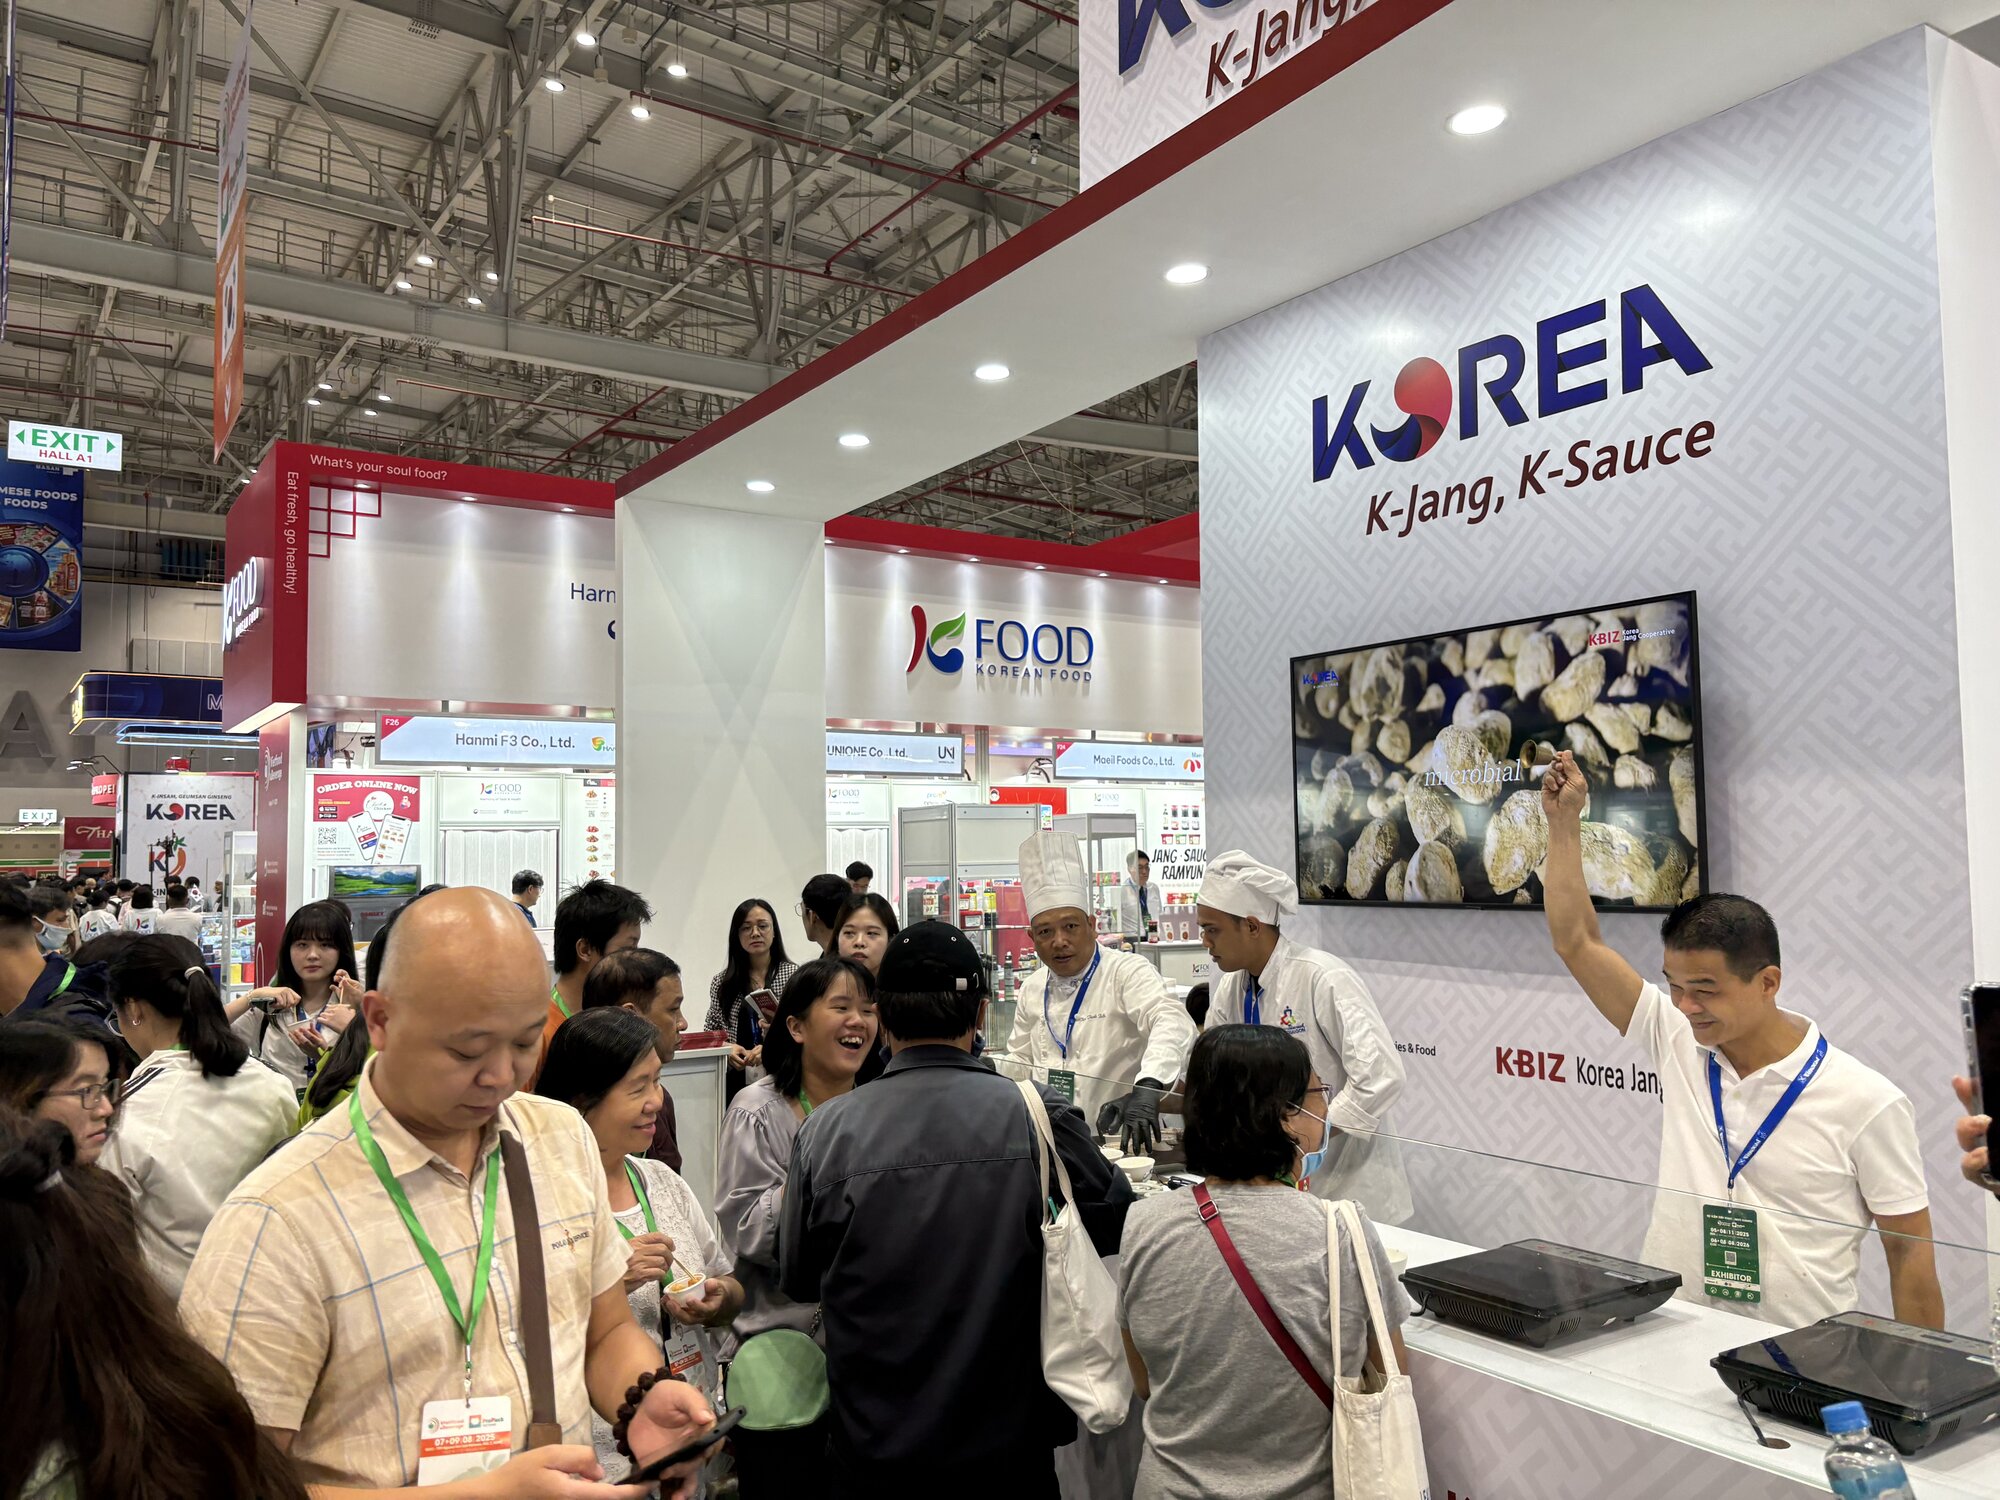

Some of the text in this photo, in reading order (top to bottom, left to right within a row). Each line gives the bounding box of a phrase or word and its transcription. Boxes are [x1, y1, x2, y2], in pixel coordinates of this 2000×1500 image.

[1312, 283, 1714, 483] KOREA
[31, 428, 99, 453] EXIT
[39, 449, 73, 461] HALL
[310, 453, 448, 480] What's your soul food?
[1365, 419, 1716, 539] K-Jang, K-Sauce
[34, 489, 78, 502] FOODS
[4, 498, 48, 510] FOODS
[283, 471, 299, 594] Eat fresh, go healthy!
[232, 556, 257, 623] FOOD
[1622, 628, 1640, 636] Korea
[1622, 628, 1675, 642] Jang Cooperative
[975, 619, 1094, 668] FOOD
[976, 664, 1092, 682] KOREAN FOOD
[385, 718, 400, 727] F26
[455, 733, 576, 750] Hanmi F3 Co., Ltd.
[827, 745, 867, 757] UNIONE
[889, 747, 909, 758] Ltd.
[1093, 754, 1175, 767] Maeil Foods Co., Ltd.
[1424, 758, 1521, 787] microbial
[316, 780, 419, 795] ORDER ONLINE NOW
[494, 783, 522, 793] FOOD
[22, 812, 54, 821] EXIT
[146, 803, 236, 821] KOREA
[1152, 848, 1178, 864] JANG
[1161, 865, 1204, 880] RAMYUN
[1407, 1043, 1414, 1053] &
[1415, 1044, 1436, 1057] Food
[1576, 1055, 1625, 1089] Korea
[1711, 1270, 1752, 1282] EXHIBITOR
